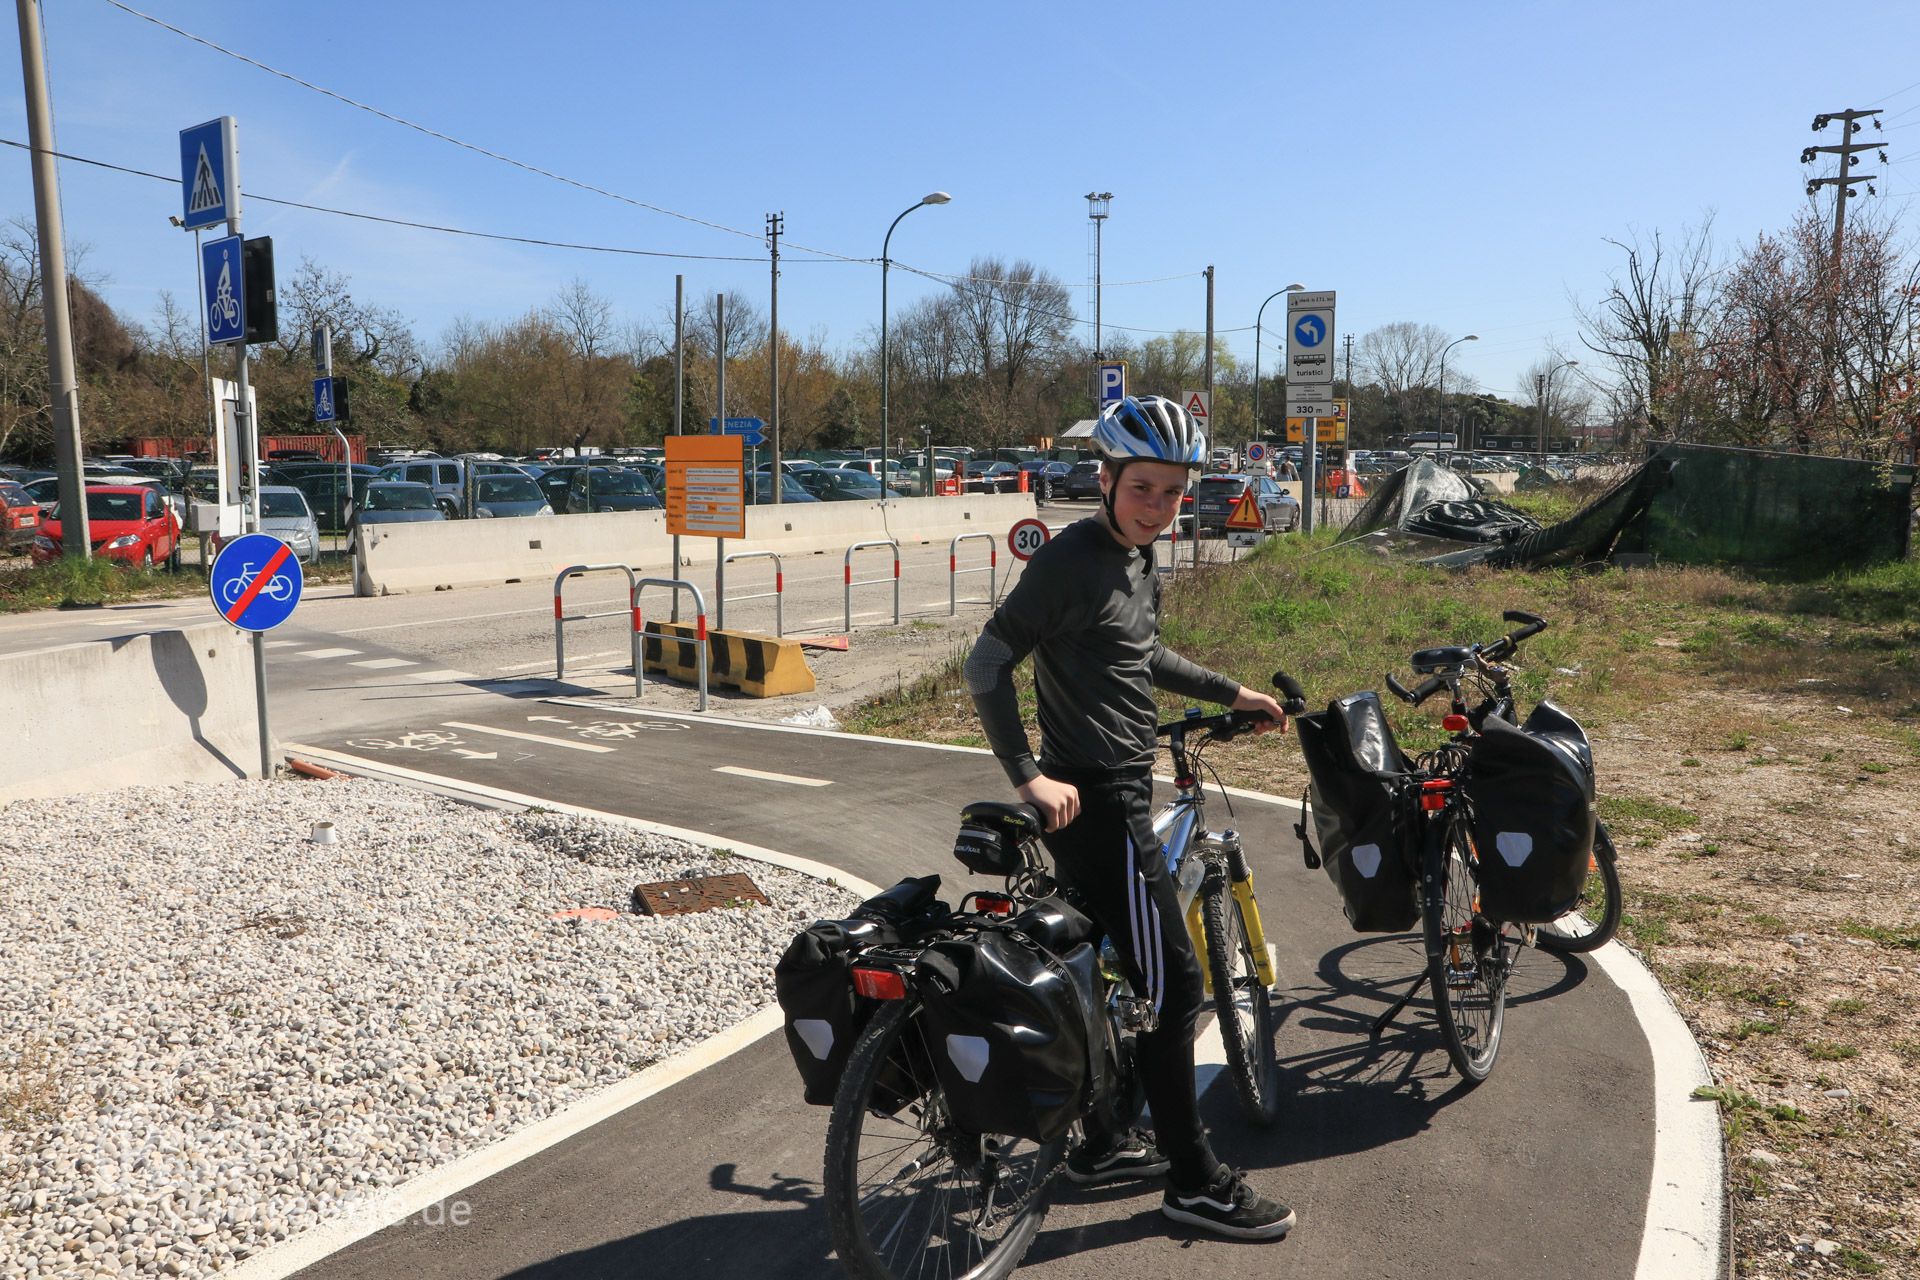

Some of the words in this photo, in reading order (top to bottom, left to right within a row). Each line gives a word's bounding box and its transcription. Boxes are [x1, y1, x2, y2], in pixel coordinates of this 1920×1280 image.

[1101, 368, 1122, 398] P
[1296, 405, 1314, 414] 330
[1018, 530, 1041, 549] 30
